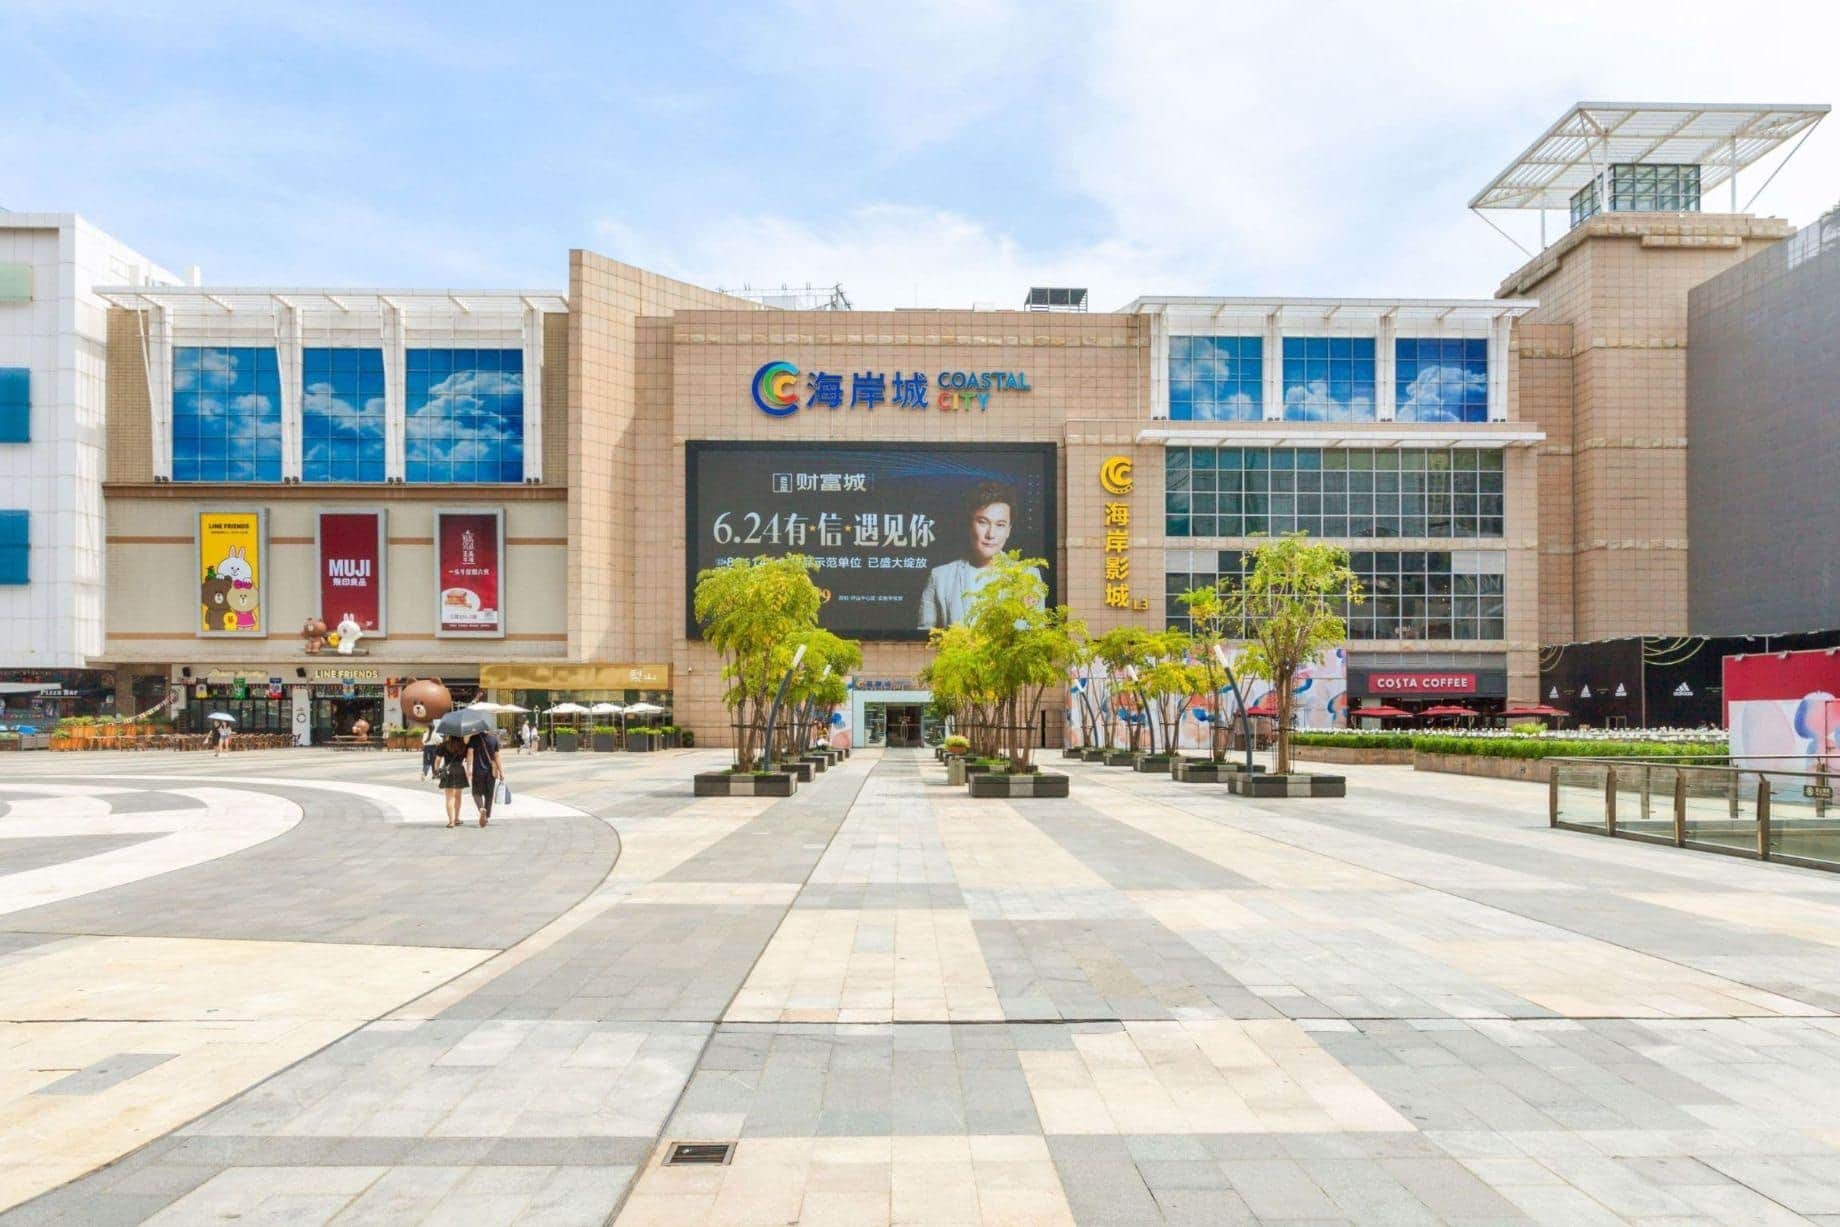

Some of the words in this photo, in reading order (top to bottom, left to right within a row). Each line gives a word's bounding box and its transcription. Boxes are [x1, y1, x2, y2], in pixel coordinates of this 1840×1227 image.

[806, 371, 928, 409] 海岸城
[937, 371, 1031, 391] COASTAL
[937, 392, 992, 411] CITY
[796, 473, 867, 492] 财富城
[868, 556, 928, 569] 已盛大绽放
[1104, 502, 1129, 608] 海岸影城
[329, 559, 371, 576] MUJI
[1132, 599, 1149, 610] L3
[315, 670, 337, 678] LINE
[338, 670, 378, 679] FRIENDS
[1377, 678, 1417, 688] COSTA
[1422, 678, 1468, 688] COFFEE
